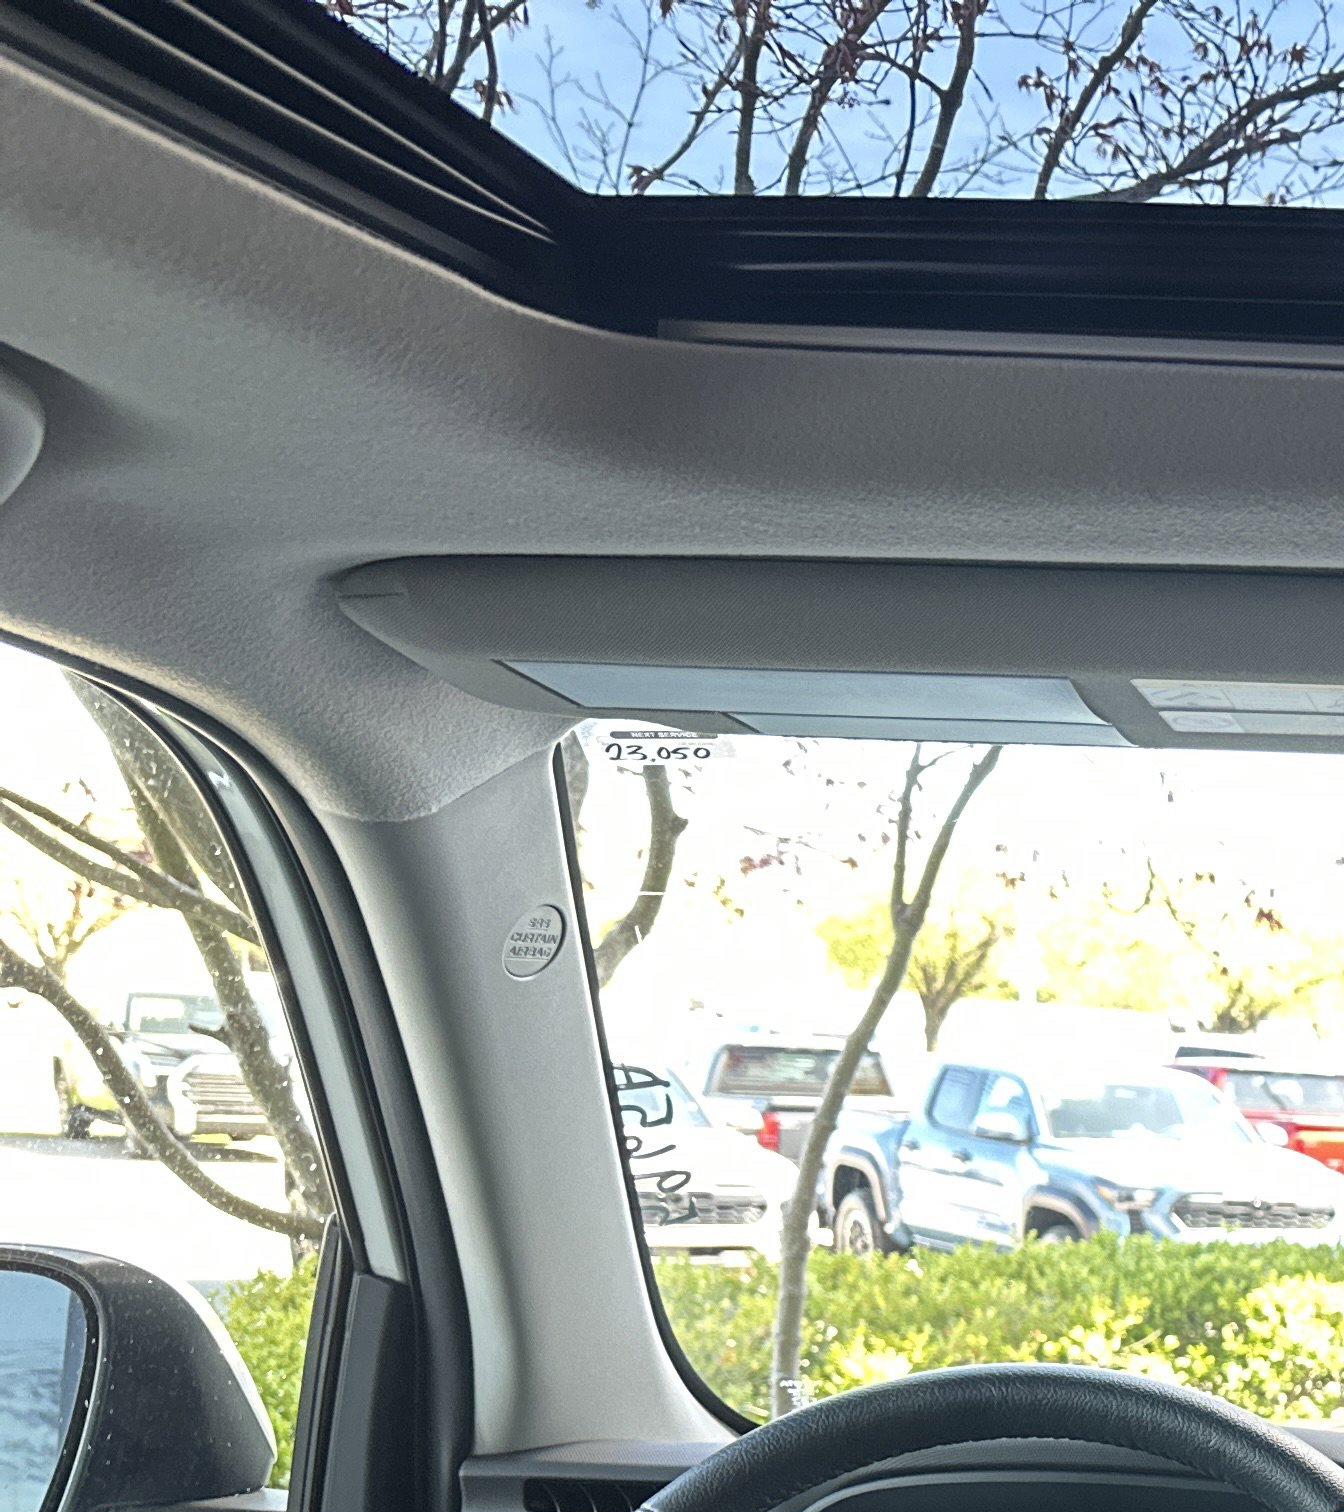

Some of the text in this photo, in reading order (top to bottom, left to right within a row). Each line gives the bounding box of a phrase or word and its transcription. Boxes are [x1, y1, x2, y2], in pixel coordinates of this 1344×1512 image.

[657, 731, 699, 739] SERVICE
[510, 932, 558, 944] CURTAIN
[509, 945, 552, 957] AIRBAG
